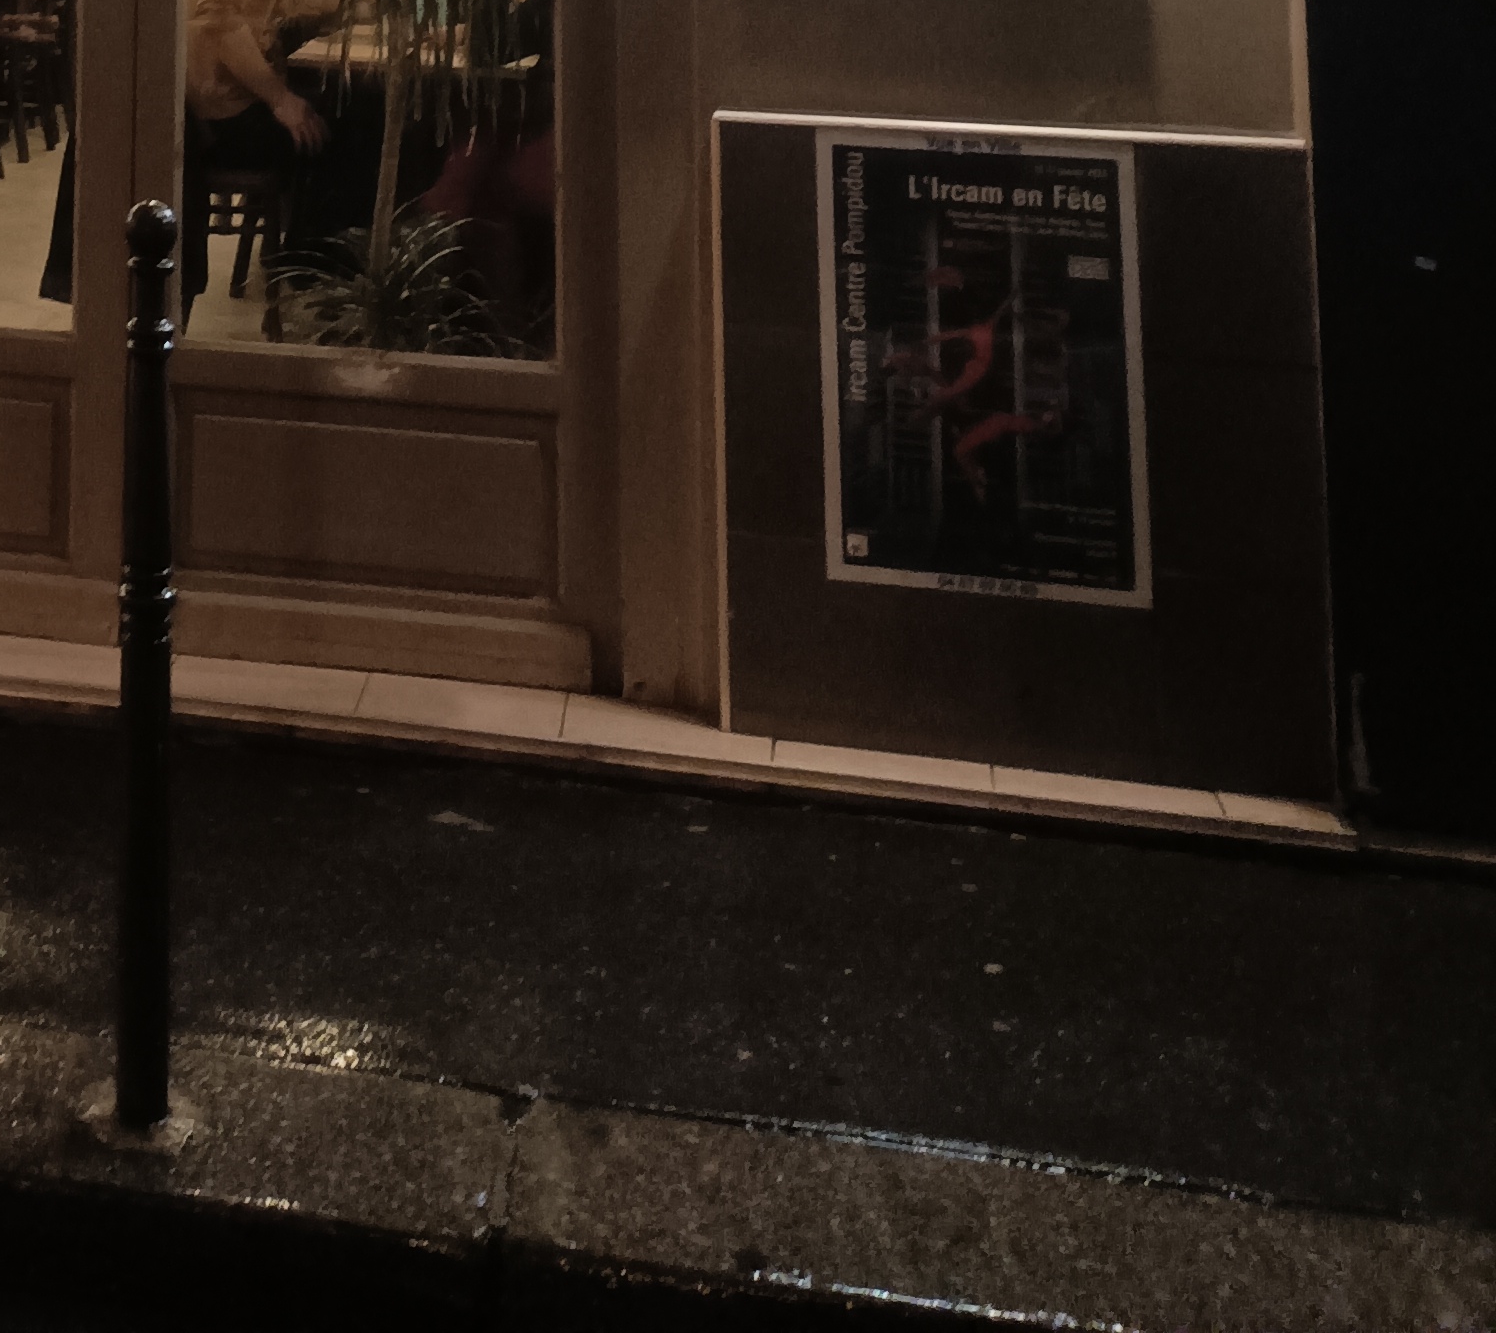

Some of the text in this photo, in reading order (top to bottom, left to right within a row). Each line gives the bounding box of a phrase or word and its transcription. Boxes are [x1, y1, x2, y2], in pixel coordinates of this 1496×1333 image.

[841, 151, 867, 255] Pompidou
[908, 174, 1108, 212] L'Ircam en Fête
